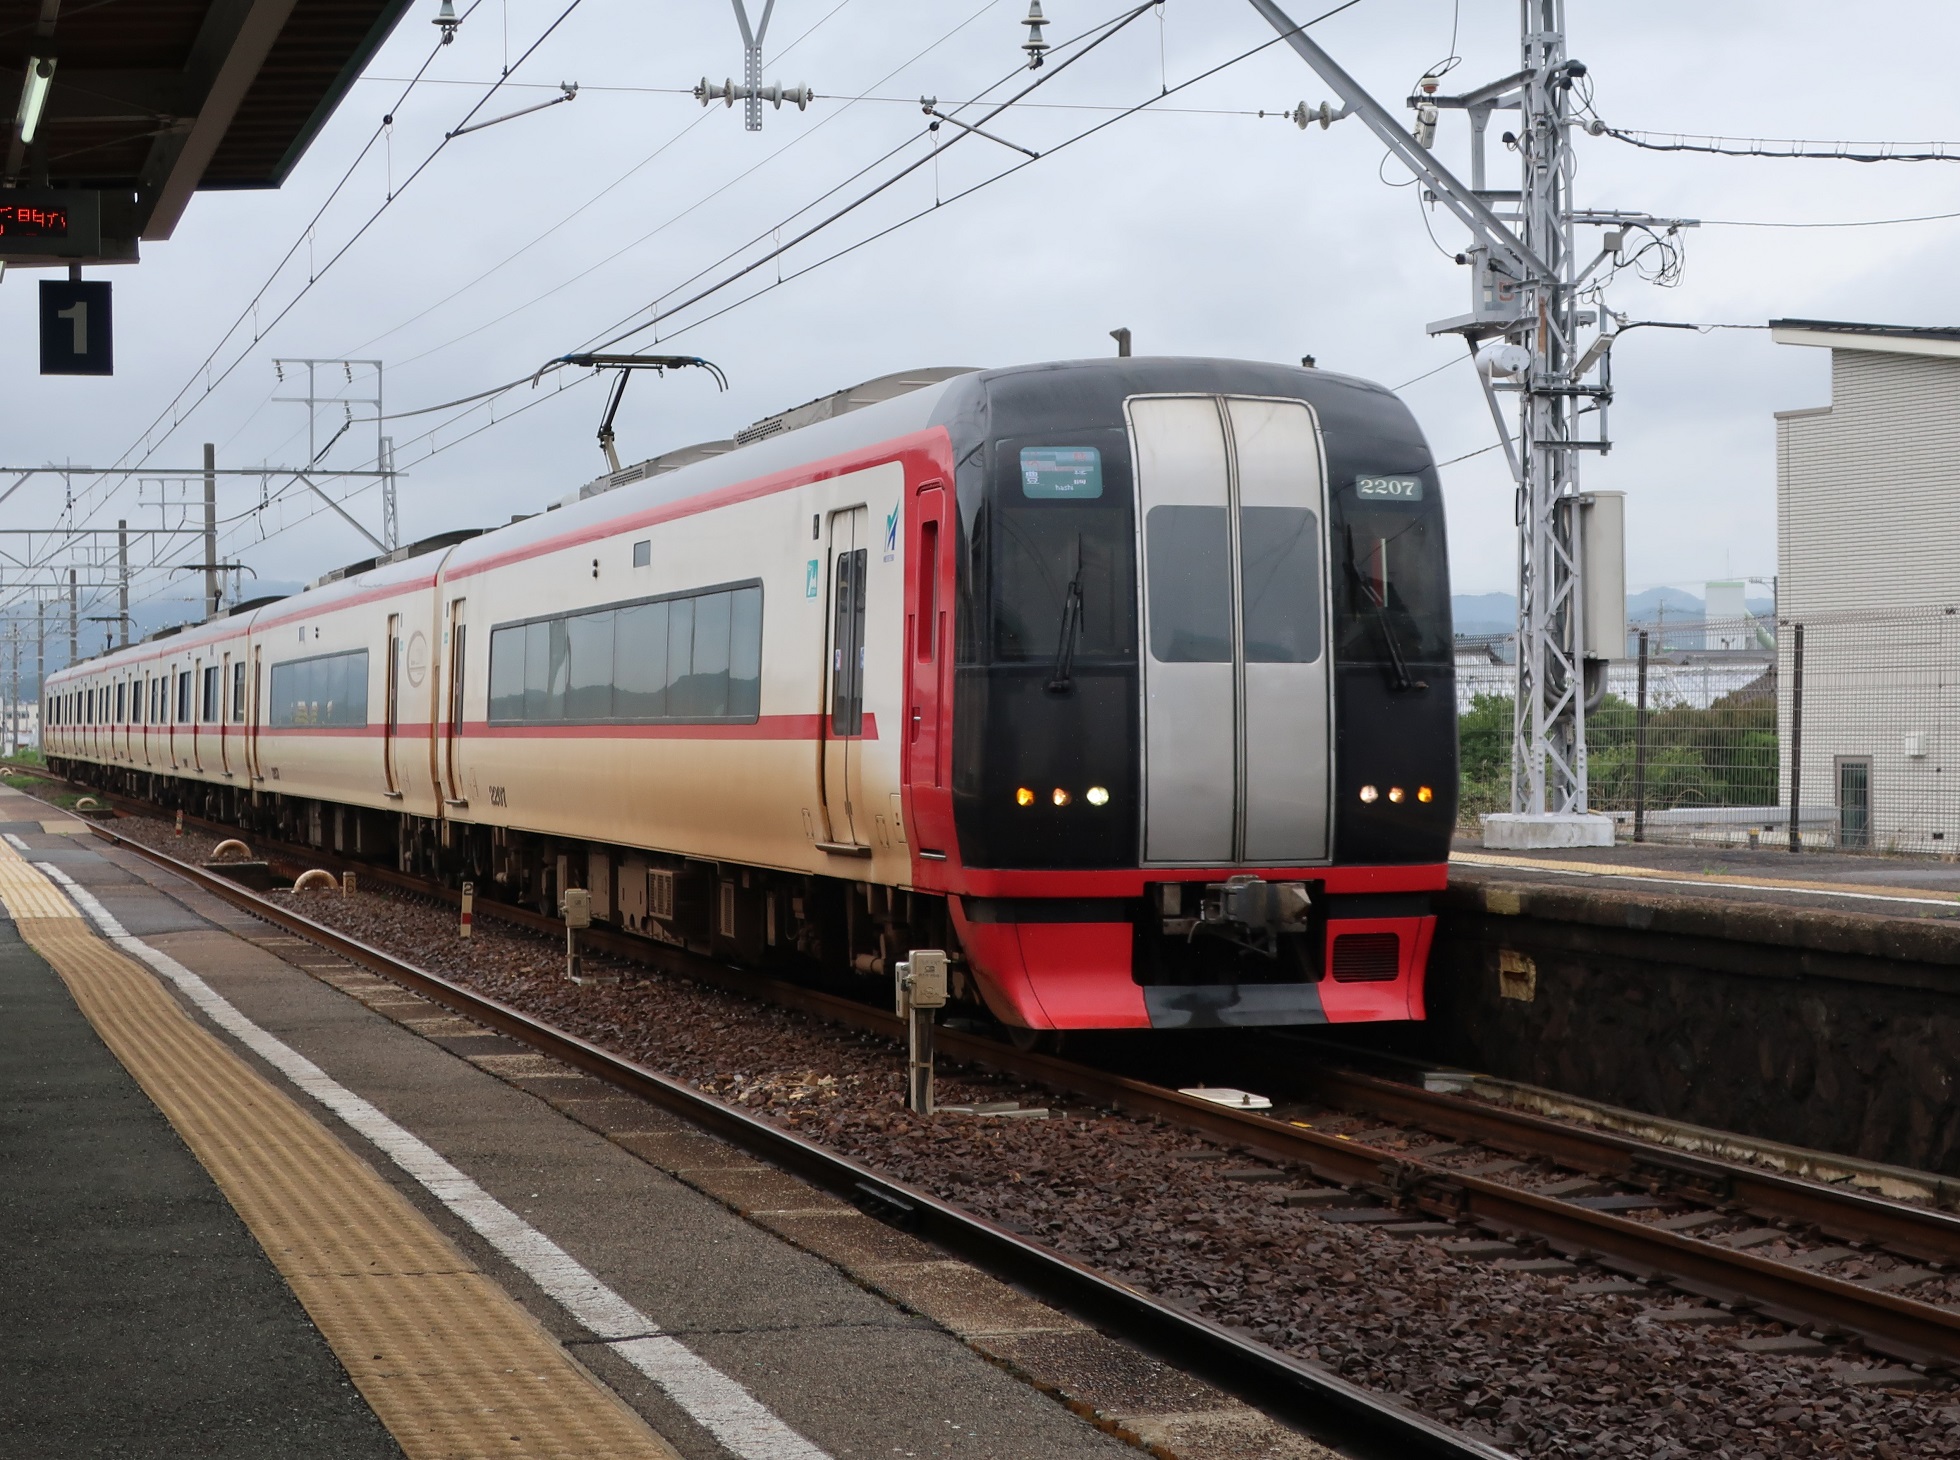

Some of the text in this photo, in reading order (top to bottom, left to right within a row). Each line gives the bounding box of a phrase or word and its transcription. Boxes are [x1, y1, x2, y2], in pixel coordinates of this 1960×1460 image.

[58, 301, 88, 355] 1
[1360, 479, 1415, 496] 2207
[463, 882, 473, 896] 2
